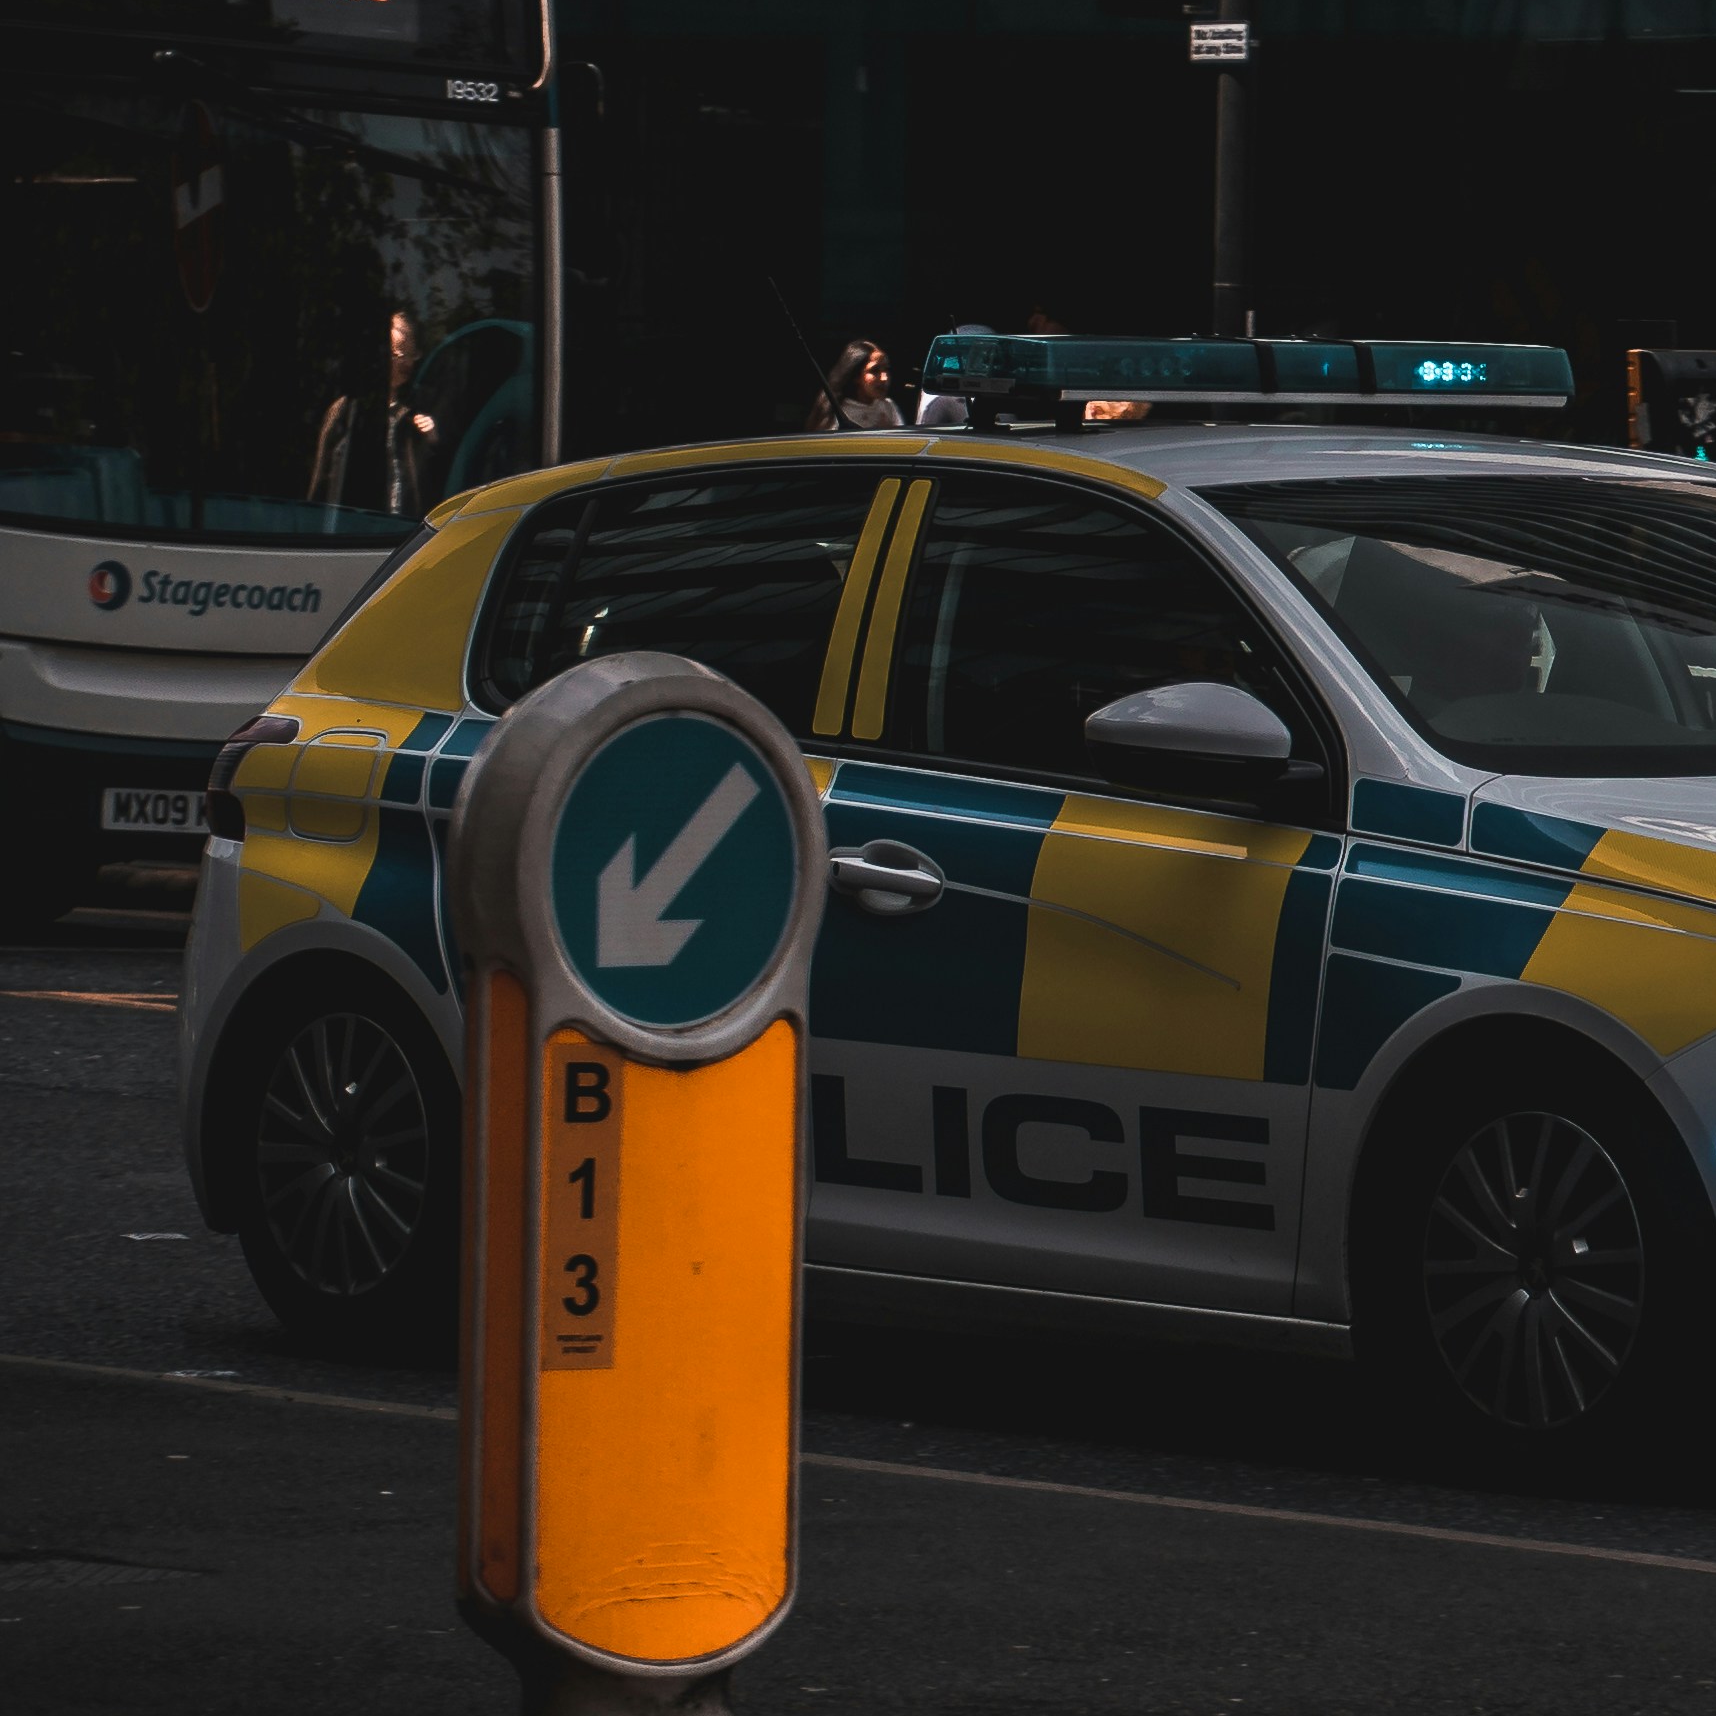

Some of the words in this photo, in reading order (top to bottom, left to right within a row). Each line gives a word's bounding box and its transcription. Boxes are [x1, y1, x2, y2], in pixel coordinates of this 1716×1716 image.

[446, 79, 499, 102] 19532
[138, 570, 321, 616] Stagecoach
[113, 792, 189, 825] MX09
[811, 1073, 1275, 1230] LICE
